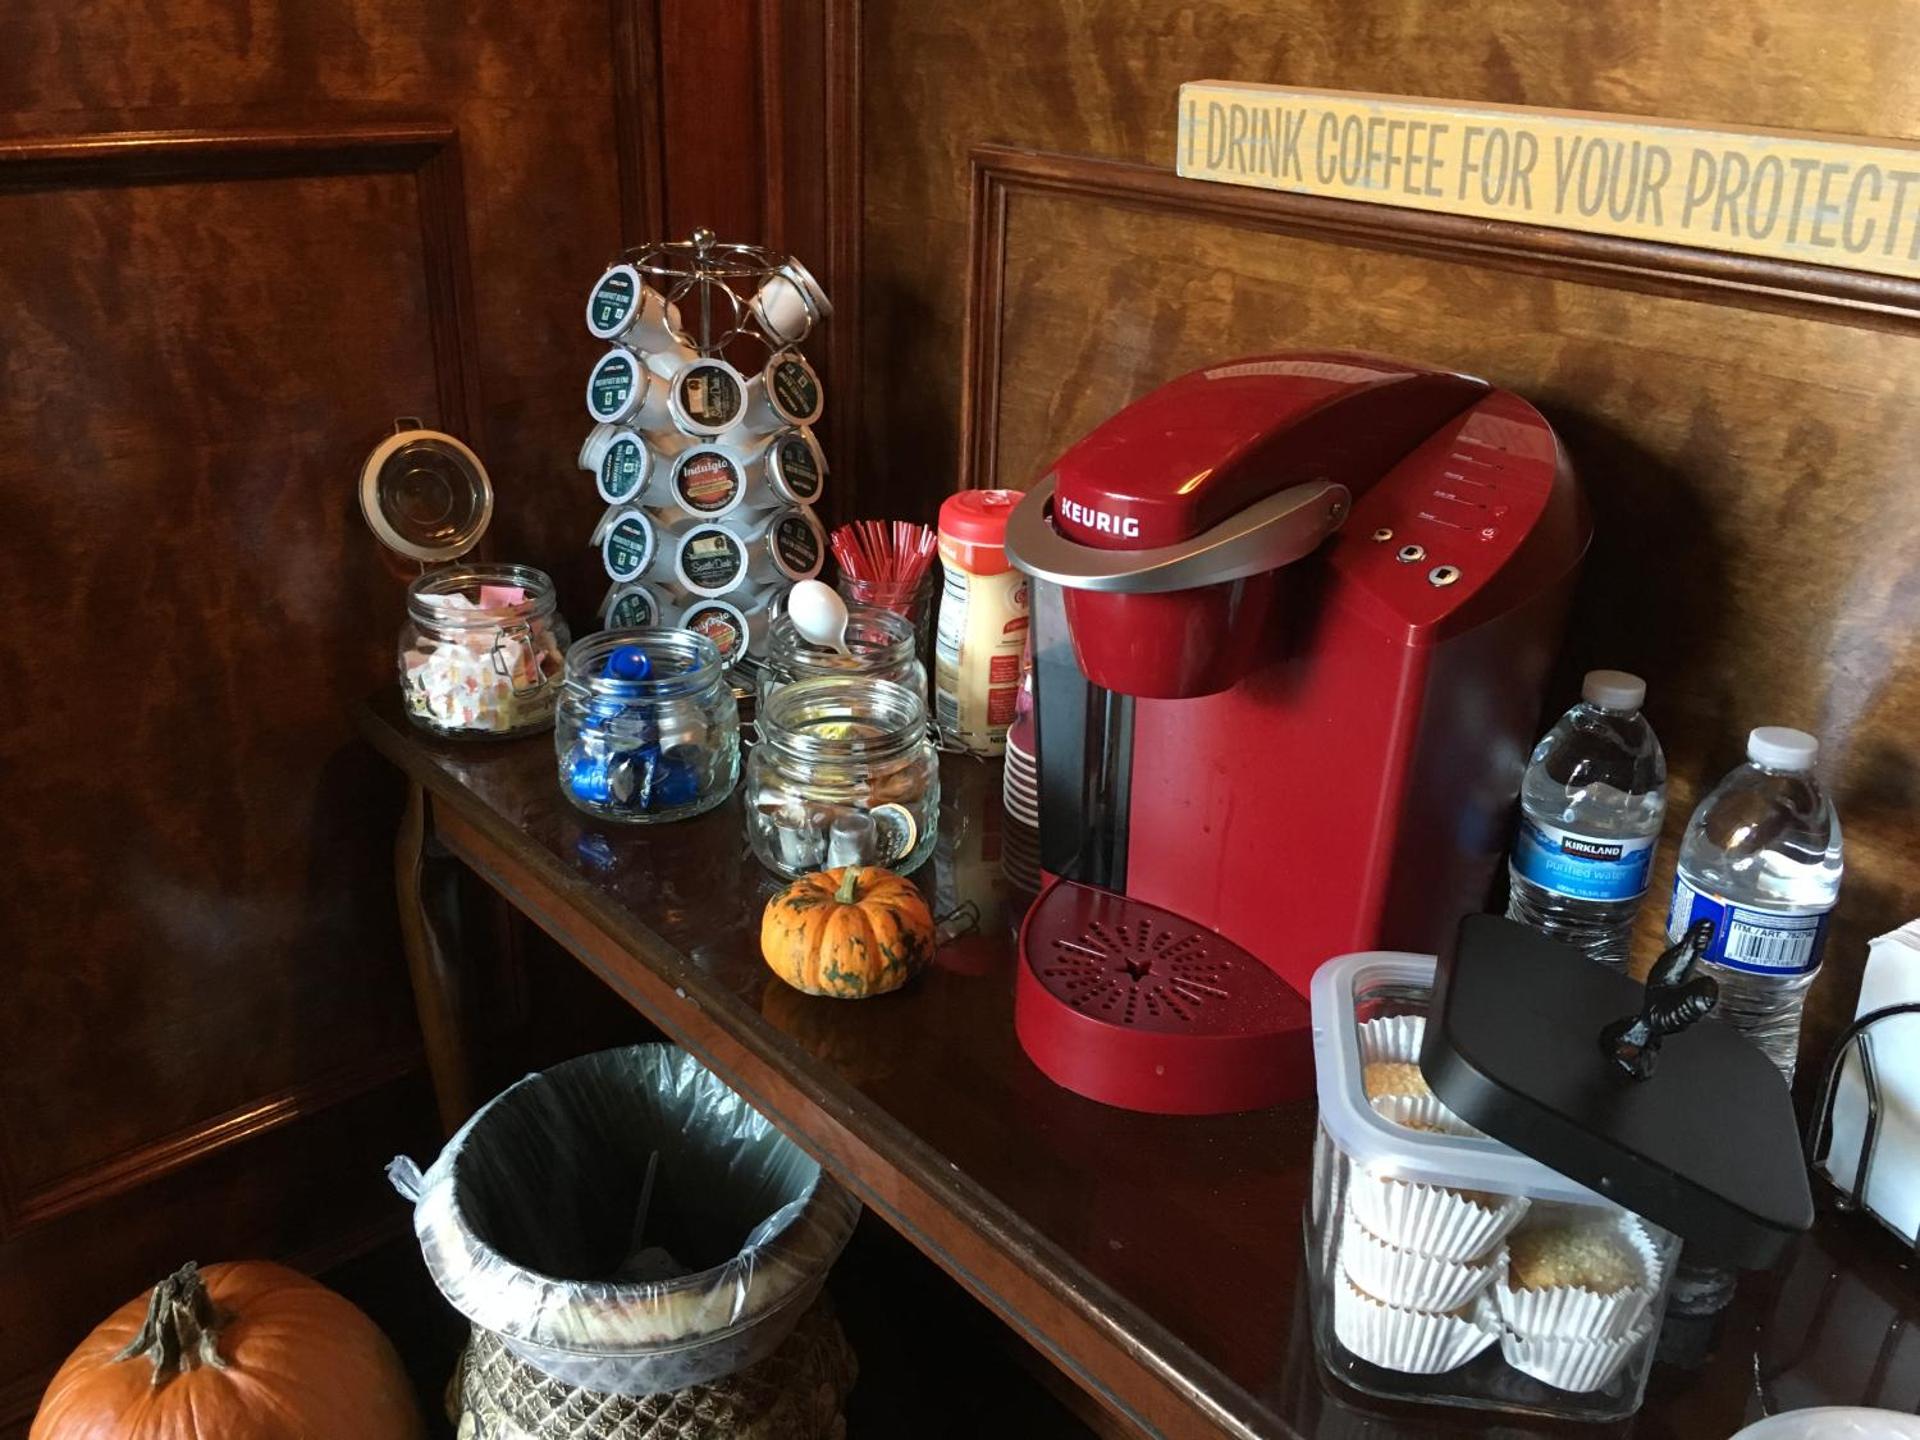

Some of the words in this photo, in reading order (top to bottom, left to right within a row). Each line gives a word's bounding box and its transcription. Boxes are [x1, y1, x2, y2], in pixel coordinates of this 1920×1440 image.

[1188, 100, 1196, 167] I
[1206, 101, 1307, 182] DRINK
[1316, 111, 1450, 197] COFFEE
[1458, 125, 1539, 210] FOR
[1554, 135, 1672, 227] YOUR
[1062, 497, 1139, 537] KEURIG
[1565, 840, 1620, 856] KIRKLAND
